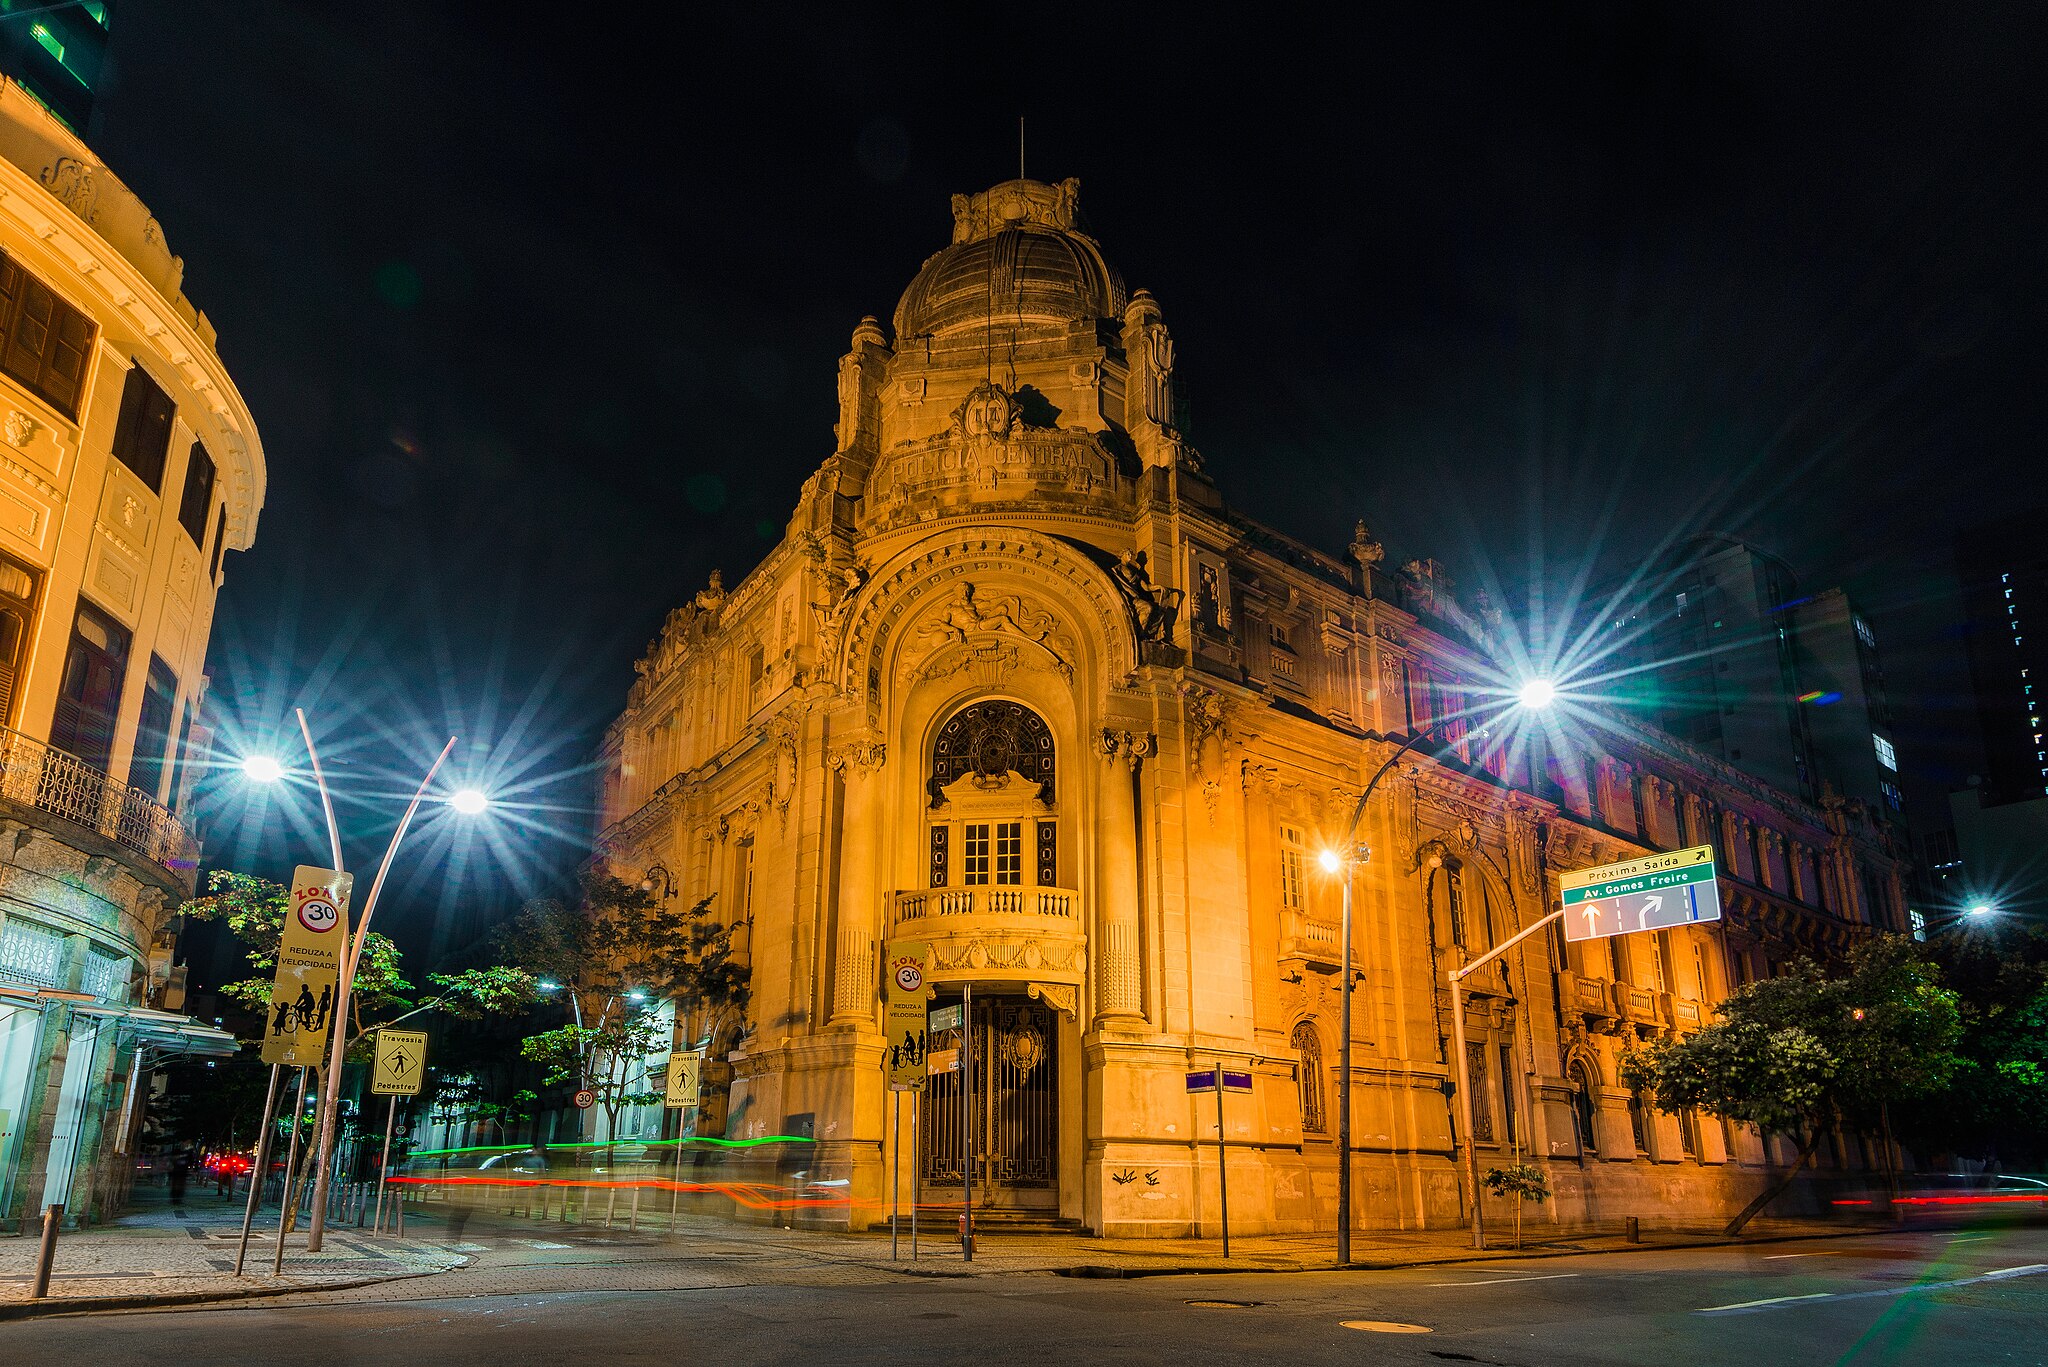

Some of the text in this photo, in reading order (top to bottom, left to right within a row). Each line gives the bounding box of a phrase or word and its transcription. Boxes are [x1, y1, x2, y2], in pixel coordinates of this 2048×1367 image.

[891, 444, 1092, 484] POLICIA CENTRAL
[1588, 858, 1679, 881] Próxima Saída
[1584, 873, 1688, 899] Av. Gomes Freire
[308, 904, 335, 921] 30
[289, 946, 325, 957] REDUZA
[281, 957, 337, 970] VELOCIDADE
[891, 957, 925, 971] ZONA
[902, 969, 920, 983] 30
[382, 1034, 422, 1044] Travessia
[376, 1082, 416, 1090] Pedestres
[578, 1093, 591, 1103] 30
